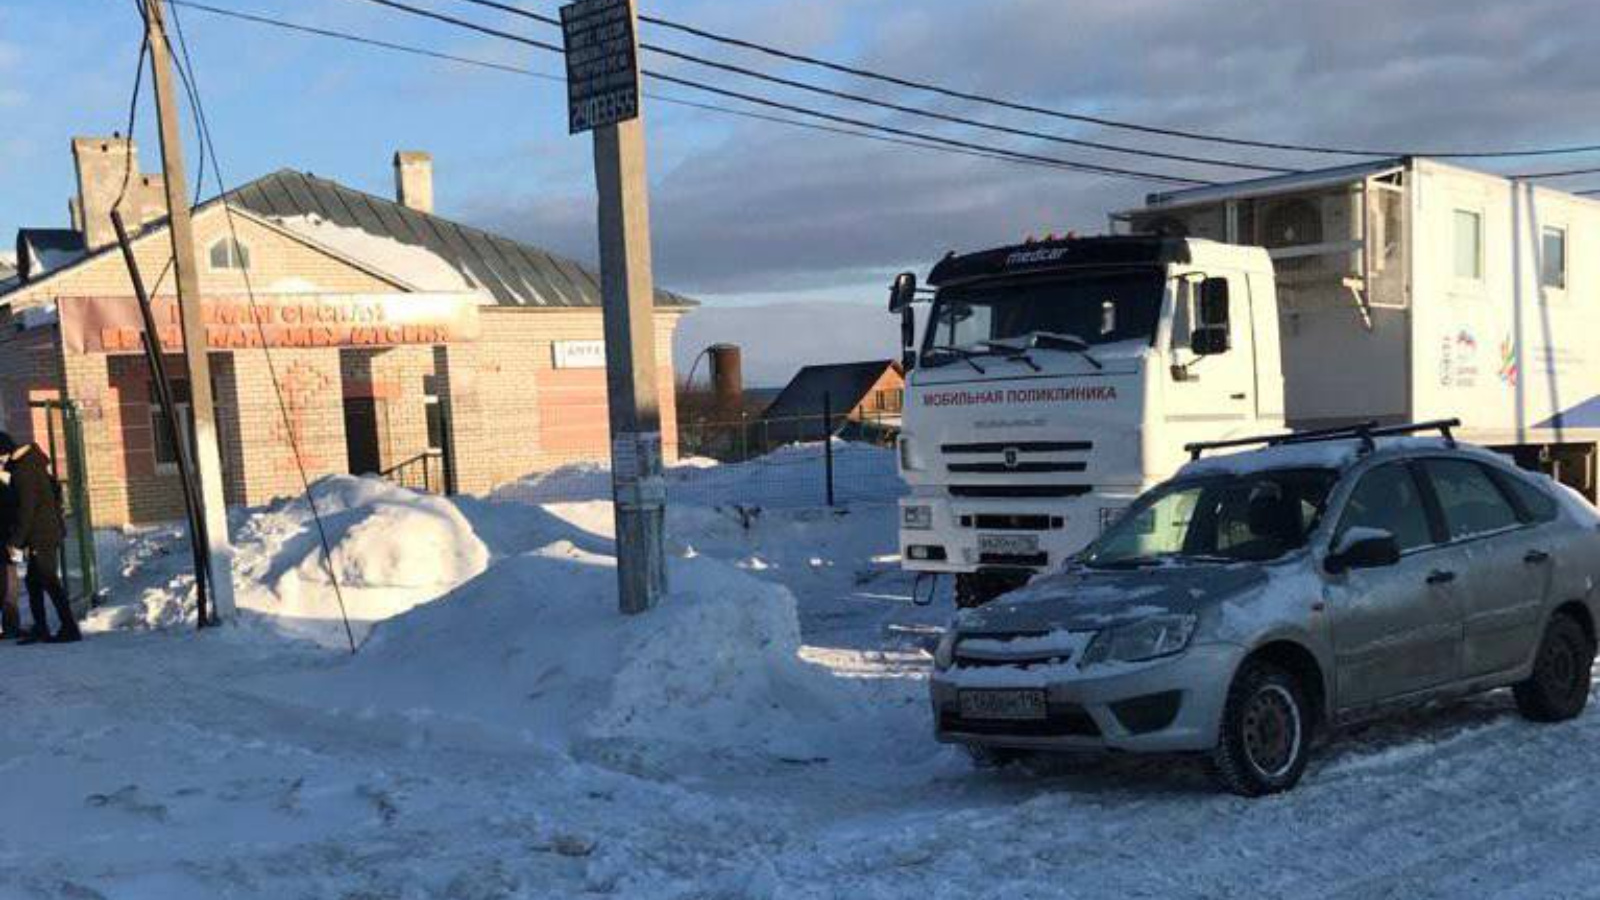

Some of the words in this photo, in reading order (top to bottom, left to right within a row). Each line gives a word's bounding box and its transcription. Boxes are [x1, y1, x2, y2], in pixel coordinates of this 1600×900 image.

[1006, 247, 1068, 265] medcar
[923, 389, 1004, 406] МОБИЛЬНАЯ
[1007, 386, 1117, 403] ПОЛИКЛИНИКА
